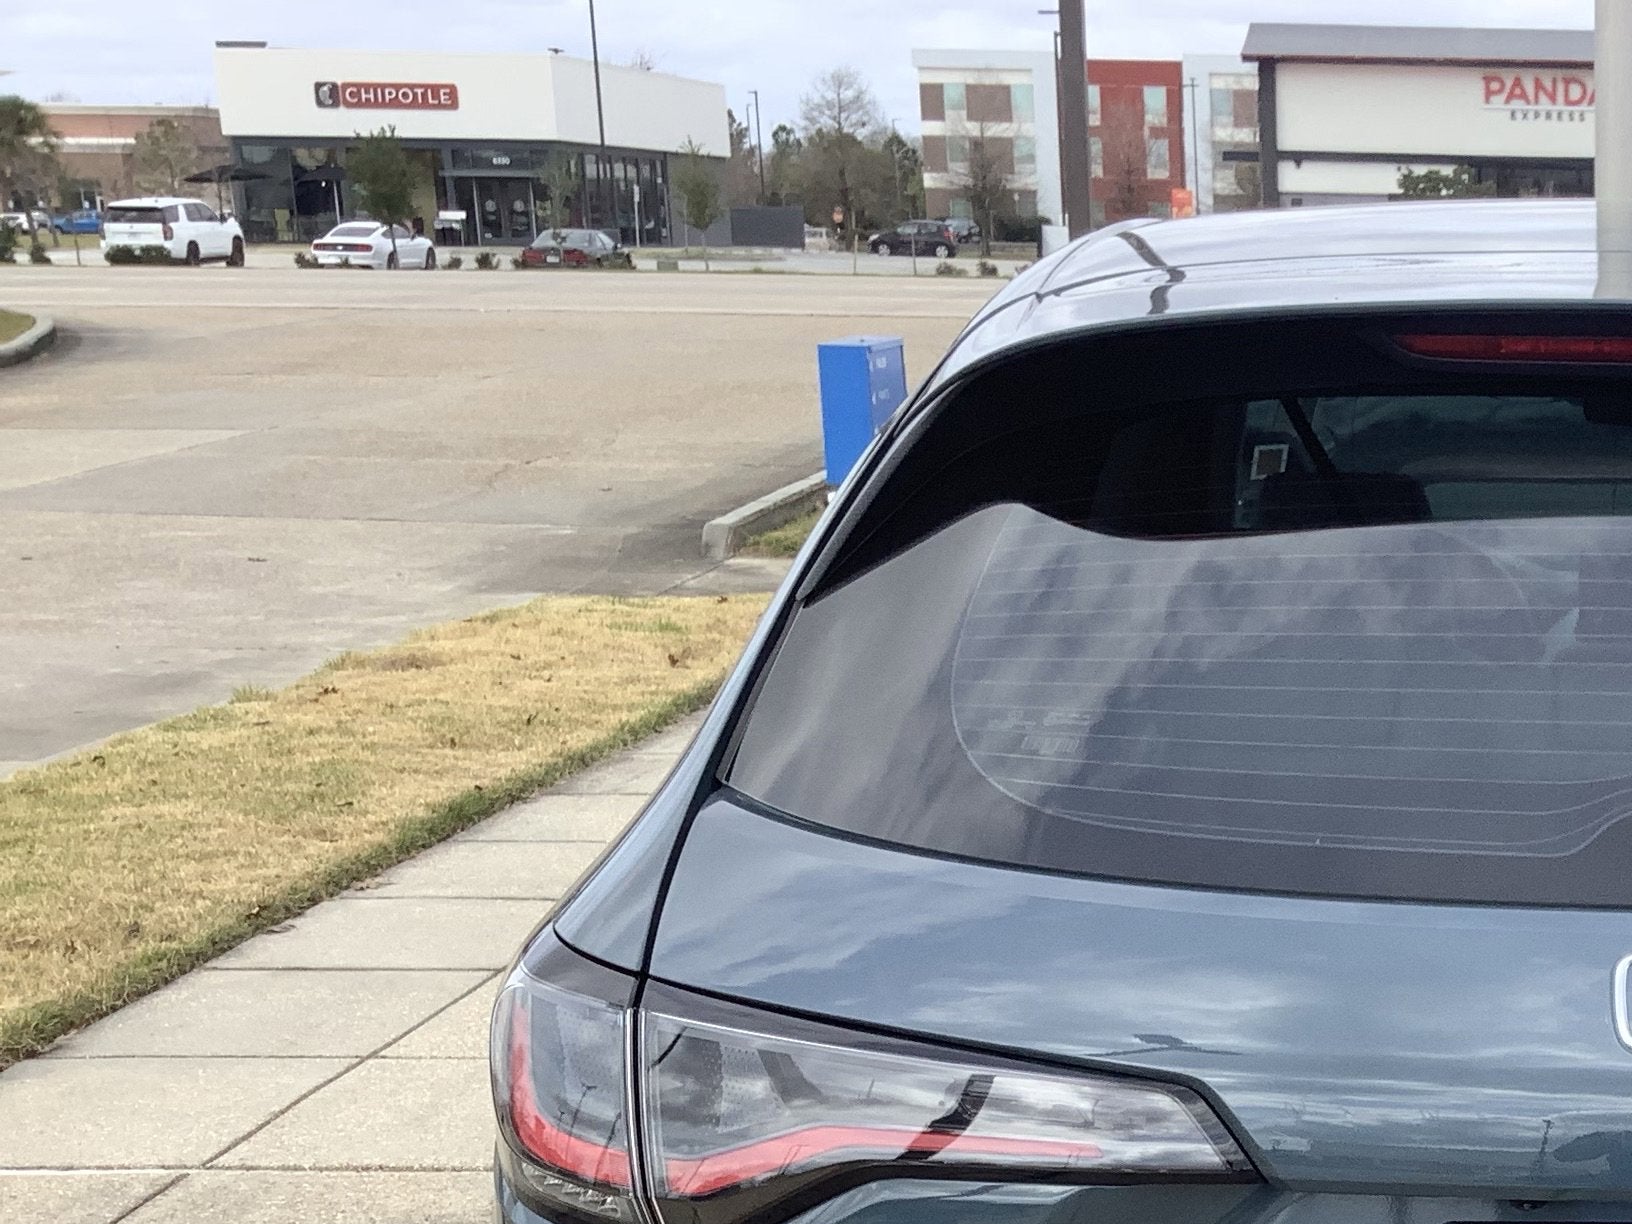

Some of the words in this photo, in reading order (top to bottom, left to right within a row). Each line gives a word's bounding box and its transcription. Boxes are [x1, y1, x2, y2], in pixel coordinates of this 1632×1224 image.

[345, 86, 452, 104] CHIPOTLE
[1482, 75, 1595, 106] PAND
[1510, 109, 1585, 121] EXPRESS
